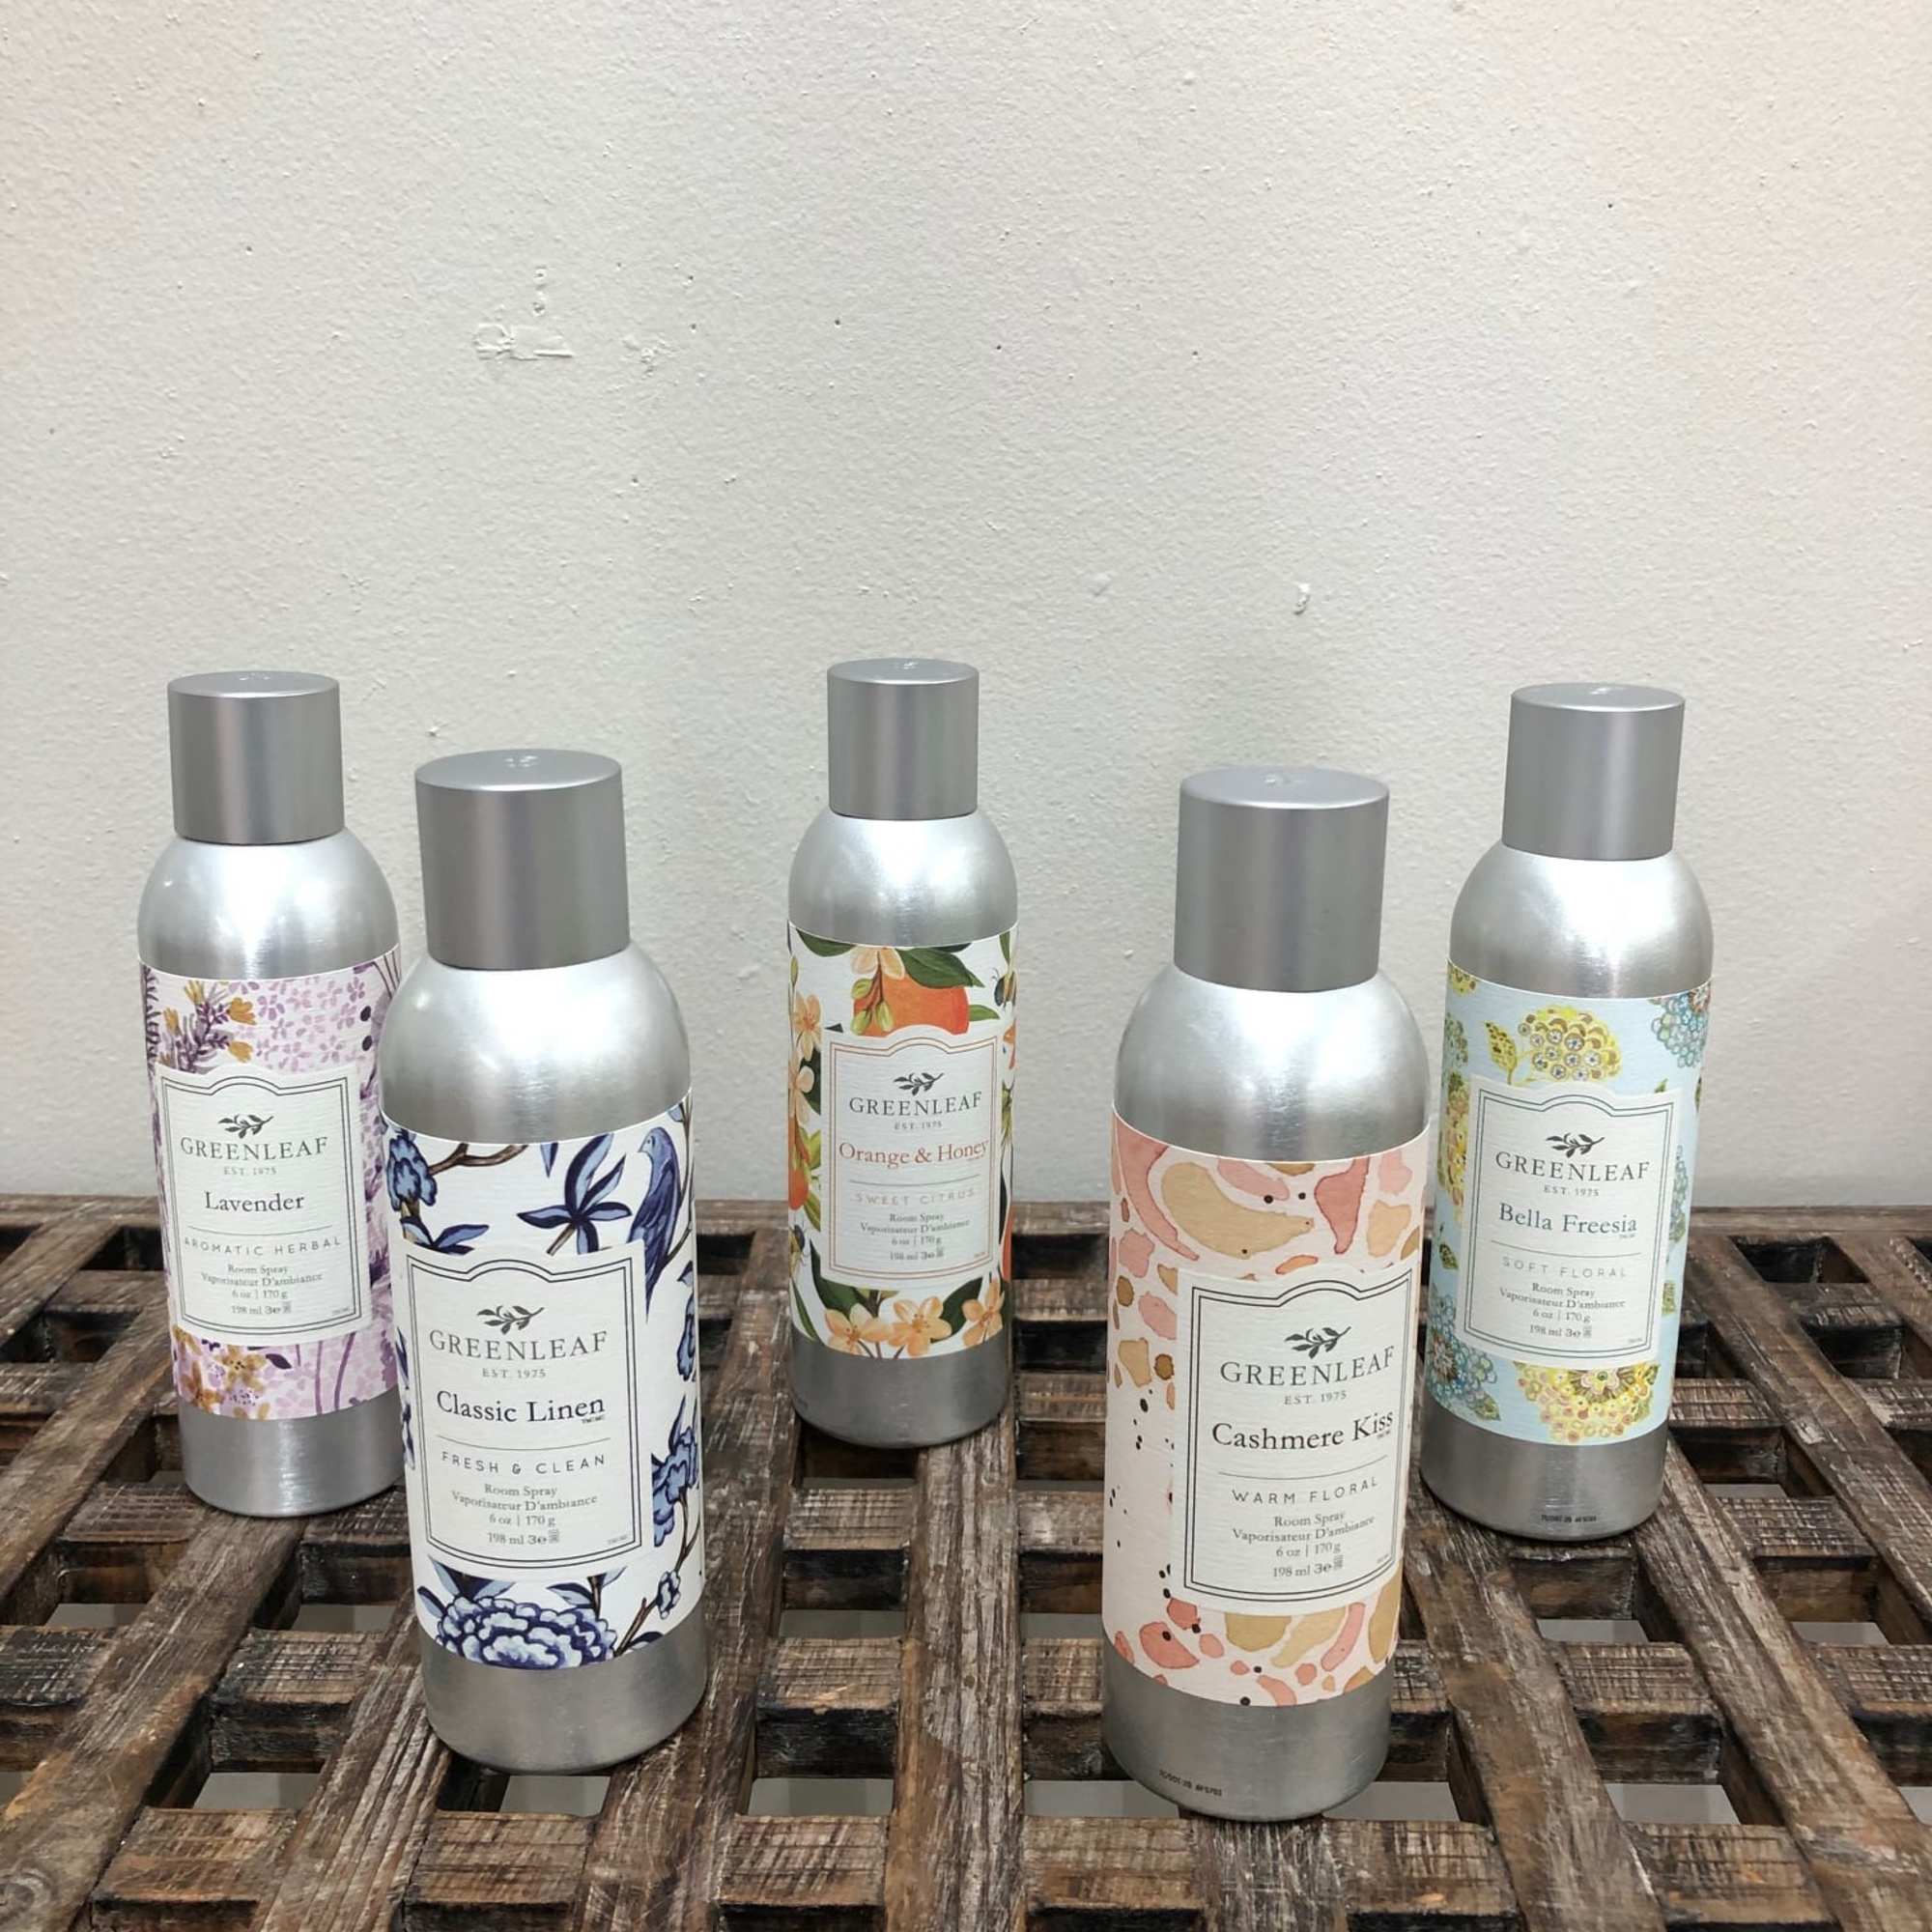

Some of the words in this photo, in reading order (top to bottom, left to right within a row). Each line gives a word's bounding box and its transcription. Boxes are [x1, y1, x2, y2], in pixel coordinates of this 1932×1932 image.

[849, 1092, 981, 1117] GREENLEAF
[180, 1136, 328, 1160] GREENLEAF
[839, 1142, 910, 1170] Orange
[915, 1148, 931, 1164] &
[938, 1140, 989, 1161] Honey
[1495, 1151, 1650, 1181] GREENLEAF
[204, 1191, 305, 1212] Lavender
[854, 1193, 911, 1206] SWEET
[920, 1188, 974, 1205] CITRUS
[1576, 1187, 1600, 1196] 1975
[1499, 1203, 1552, 1230] Bella
[1563, 1214, 1637, 1234] Freesia
[185, 1237, 264, 1256] AROMATIC
[274, 1236, 341, 1255] HERBAL
[227, 1264, 257, 1275] Room
[260, 1264, 289, 1276] Spray
[1502, 1257, 1548, 1274] SOFT
[1560, 1266, 1627, 1278] FLORAL
[1532, 1282, 1563, 1293] Room
[1566, 1286, 1595, 1299] Spray
[1565, 1312, 1582, 1321] 170
[429, 1329, 609, 1360] GREENLEAF
[517, 1368, 547, 1378] 1975
[1219, 1346, 1395, 1387] GREENLEAF
[437, 1389, 518, 1423] Classic
[526, 1398, 605, 1423] Linen
[1321, 1390, 1347, 1403] 1975
[1211, 1423, 1345, 1450] Cashmere
[1352, 1411, 1394, 1441] Kiss
[441, 1451, 499, 1473] FRESH
[511, 1463, 522, 1475] &
[535, 1454, 605, 1474] CLEAN
[484, 1484, 520, 1495] Room
[524, 1486, 557, 1499] Spray
[1232, 1490, 1296, 1504] WARM
[1309, 1477, 1378, 1503] FLORAL
[451, 1491, 522, 1511] Vaporisateur
[526, 1495, 598, 1512] D'ambiance
[489, 1514, 497, 1523] 6
[497, 1516, 511, 1525] oz
[526, 1516, 546, 1526] 170
[1274, 1516, 1312, 1527] Room
[1314, 1511, 1346, 1526] Spray
[488, 1532, 506, 1544] 198
[509, 1535, 525, 1545] ml
[1233, 1528, 1311, 1544] Vaporisateur
[1276, 1547, 1284, 1557] 6
[1315, 1543, 1333, 1554] 170
[1273, 1567, 1293, 1577] 198
[1294, 1566, 1310, 1577] ml
